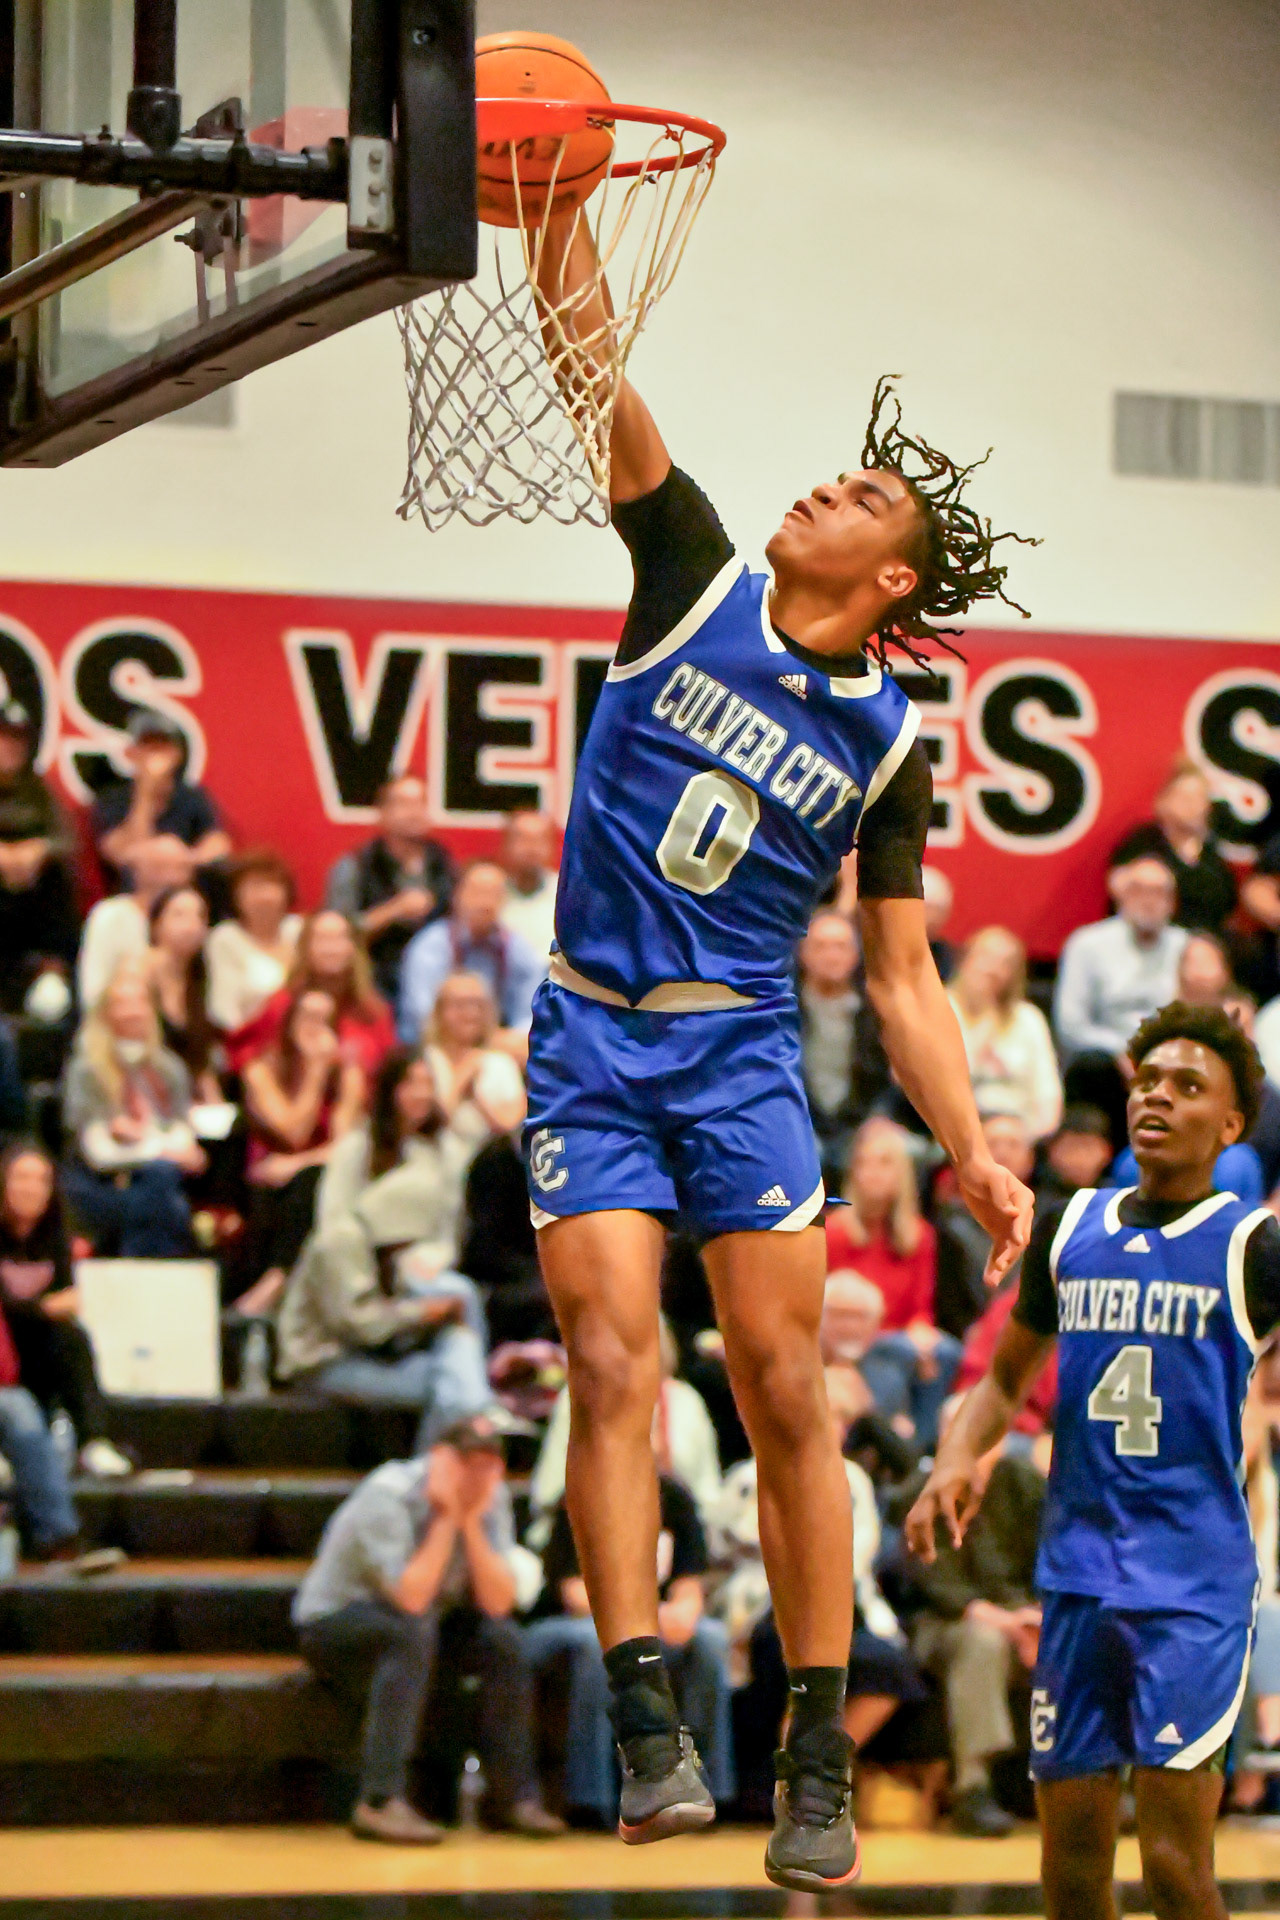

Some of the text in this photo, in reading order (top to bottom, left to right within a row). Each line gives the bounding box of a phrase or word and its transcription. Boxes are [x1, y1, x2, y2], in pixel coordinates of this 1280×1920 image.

[778, 676, 807, 700] adidas
[652, 661, 862, 829] CULVER CITY
[656, 768, 760, 896] 0
[757, 1198, 791, 1208] adidas
[1142, 1280, 1221, 1340] CITY
[1088, 1344, 1162, 1457] 4
